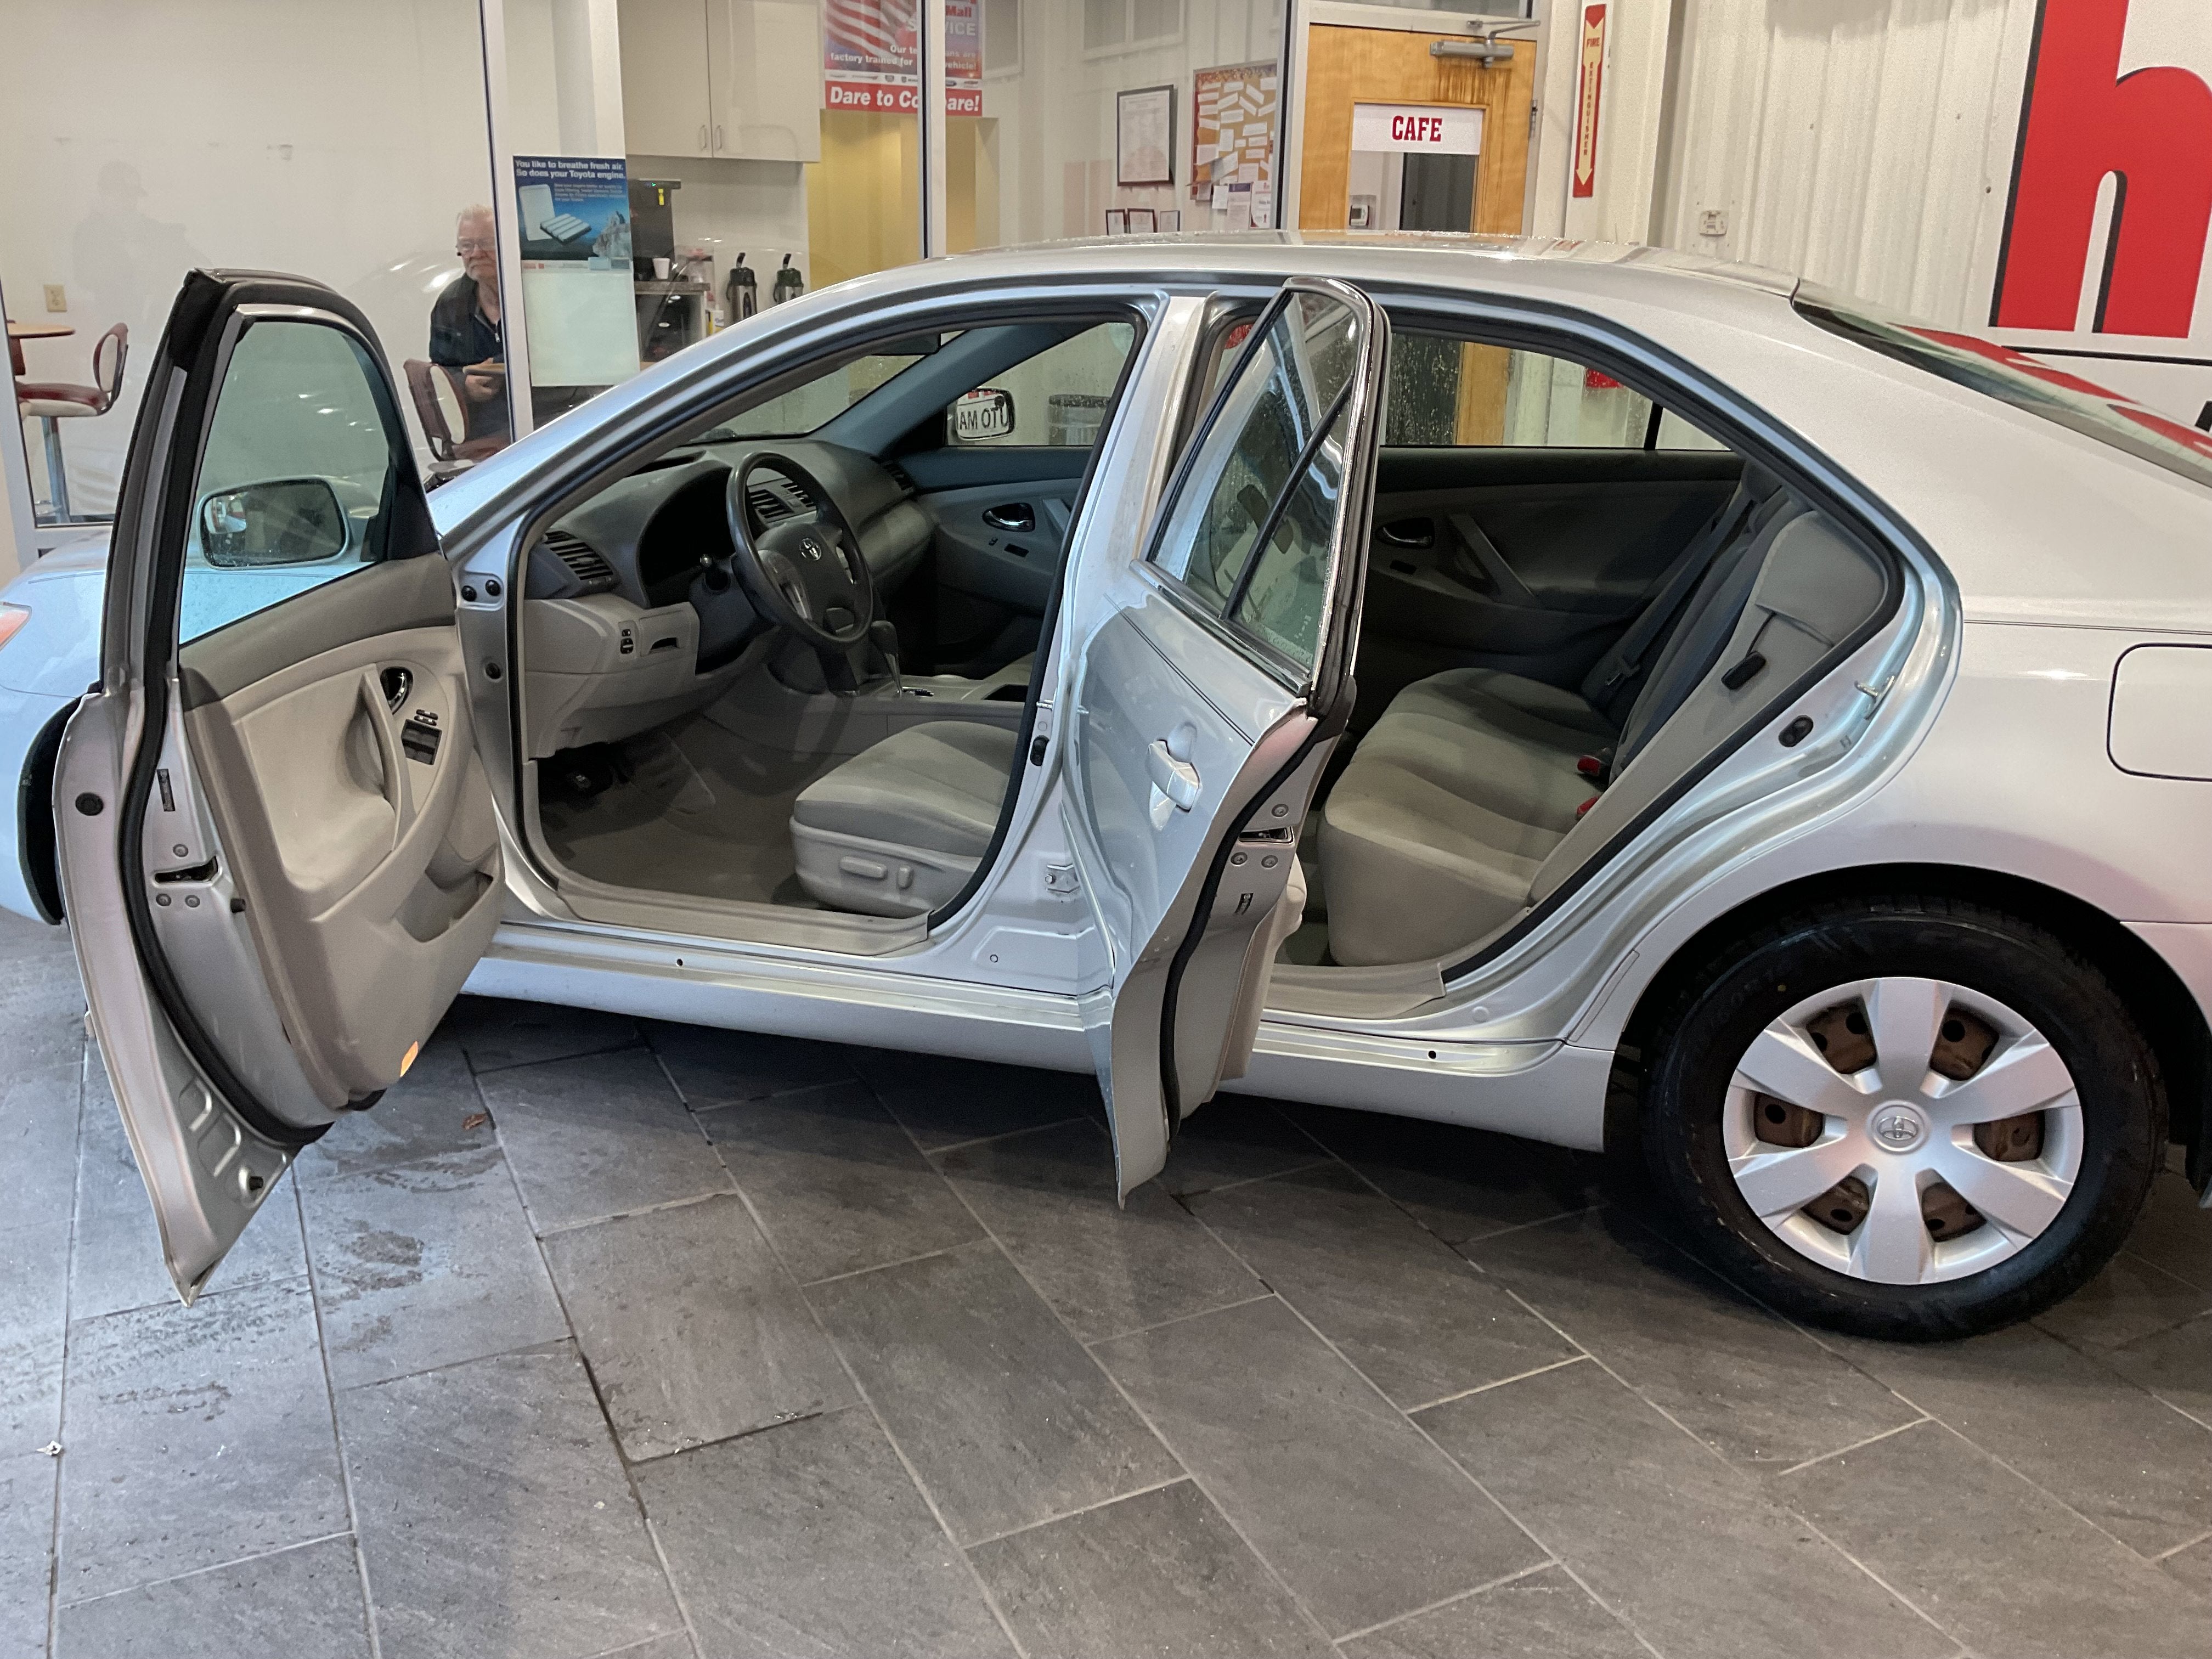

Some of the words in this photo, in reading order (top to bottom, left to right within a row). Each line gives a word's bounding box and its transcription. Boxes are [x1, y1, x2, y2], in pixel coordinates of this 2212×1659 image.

[945, 5, 972, 18] Mall
[1587, 37, 1600, 48] FIRE
[890, 45, 906, 54] Our
[831, 53, 862, 64] factory
[866, 55, 898, 65] trained
[898, 57, 913, 67] for
[831, 86, 871, 105] Dare
[877, 90, 894, 106] to
[1583, 61, 1594, 155] EXTINGUISHER
[1392, 116, 1442, 142] CAFE
[569, 170, 595, 179] Toyota
[597, 172, 625, 180] engine.
